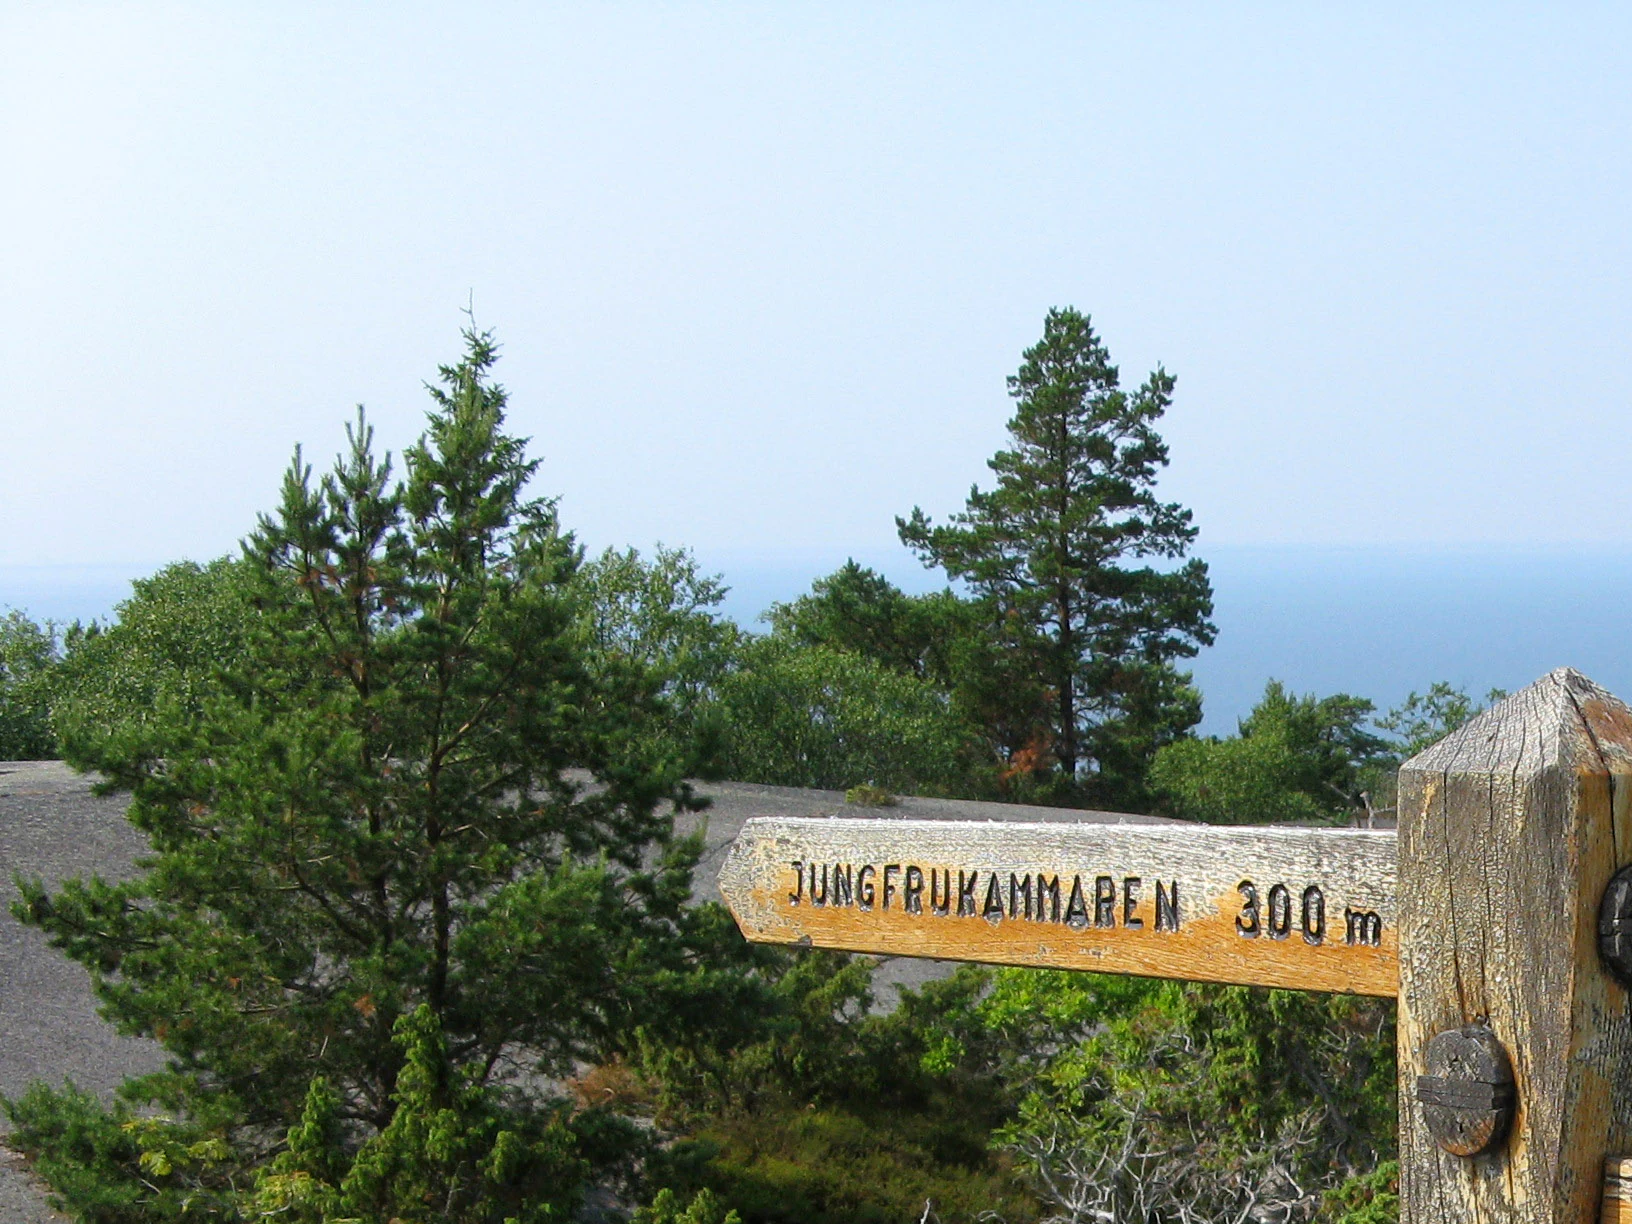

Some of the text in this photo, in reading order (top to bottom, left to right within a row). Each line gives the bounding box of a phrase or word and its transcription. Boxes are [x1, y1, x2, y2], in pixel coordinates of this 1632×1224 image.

[788, 860, 1383, 948] JUNGFRUKAMMAREN 300 m
